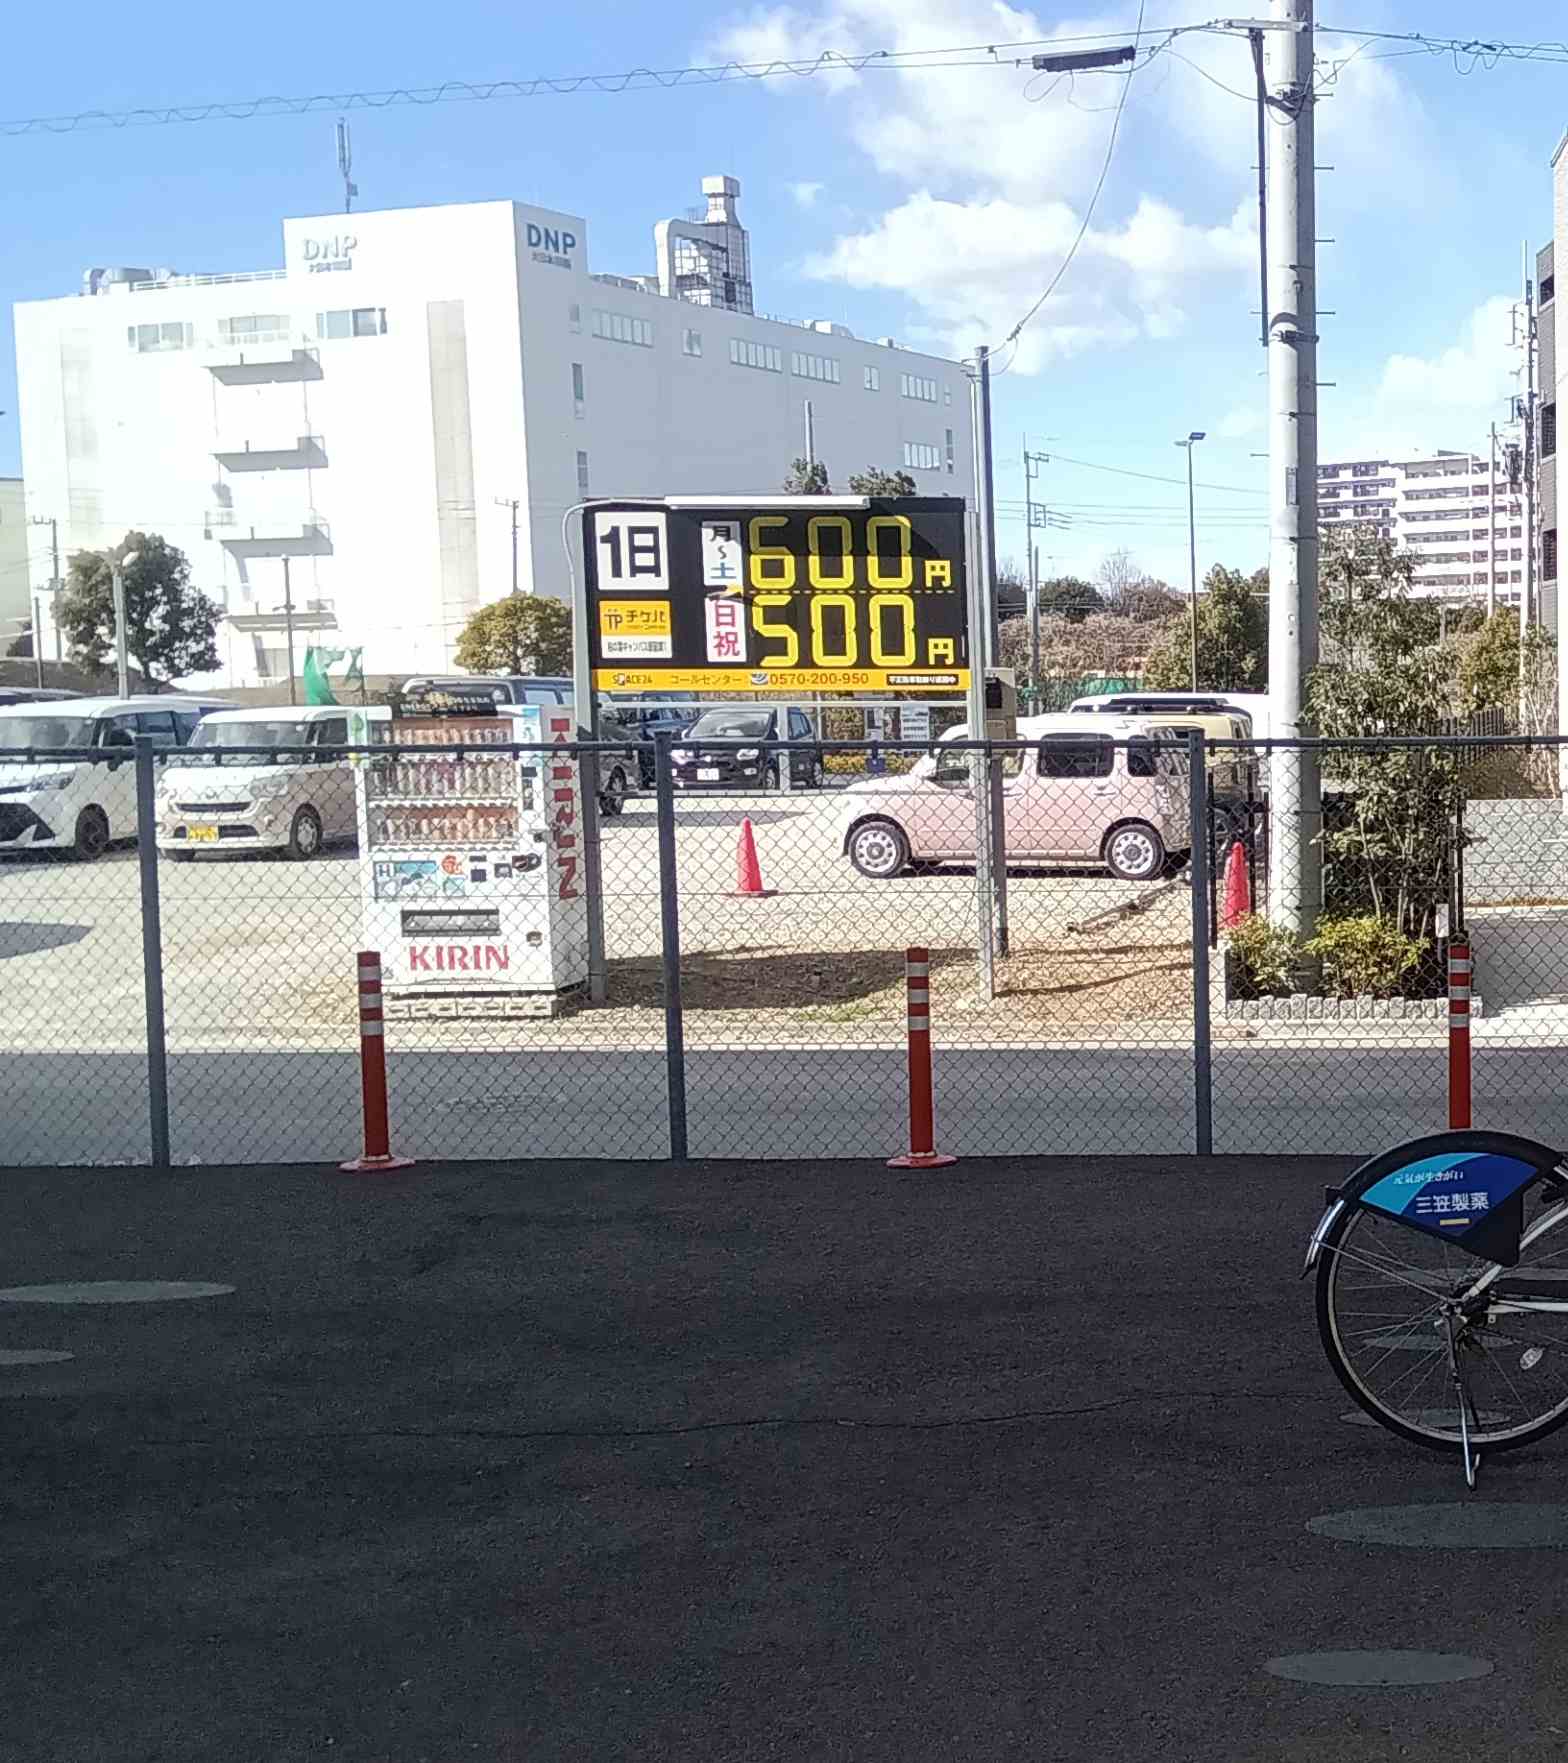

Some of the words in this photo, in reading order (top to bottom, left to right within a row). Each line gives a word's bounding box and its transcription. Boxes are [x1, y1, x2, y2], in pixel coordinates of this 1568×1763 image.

[303, 235, 357, 260] DNP
[527, 223, 576, 254] DNP
[599, 525, 661, 578] 1日
[670, 673, 742, 685] コールセンター
[769, 672, 870, 685] 0570-200-950
[409, 945, 510, 971] KIRIN
[1415, 1191, 1490, 1214] 三笠製薬
